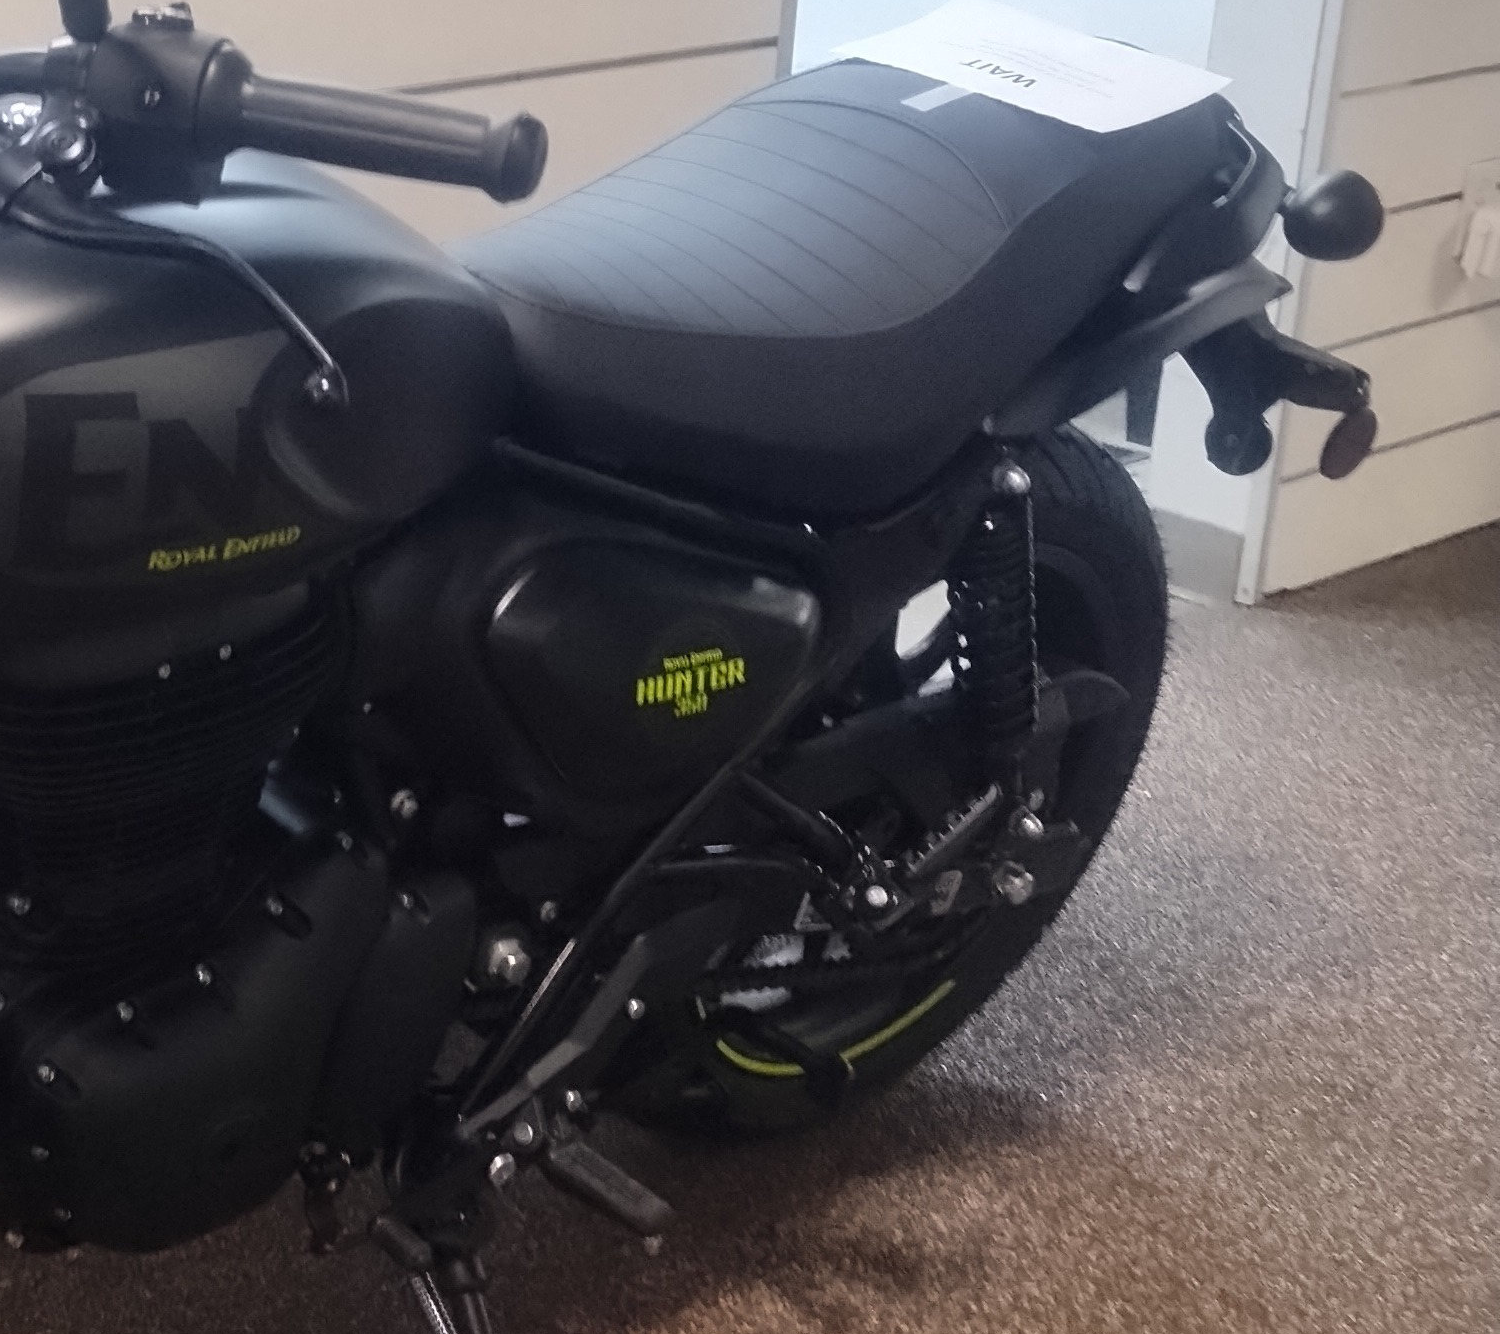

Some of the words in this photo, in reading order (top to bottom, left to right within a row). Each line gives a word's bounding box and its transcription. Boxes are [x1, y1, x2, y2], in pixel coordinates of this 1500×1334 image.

[960, 57, 1037, 88] WAIT
[148, 544, 216, 571] ROYAL
[636, 657, 746, 706] HUNTER
